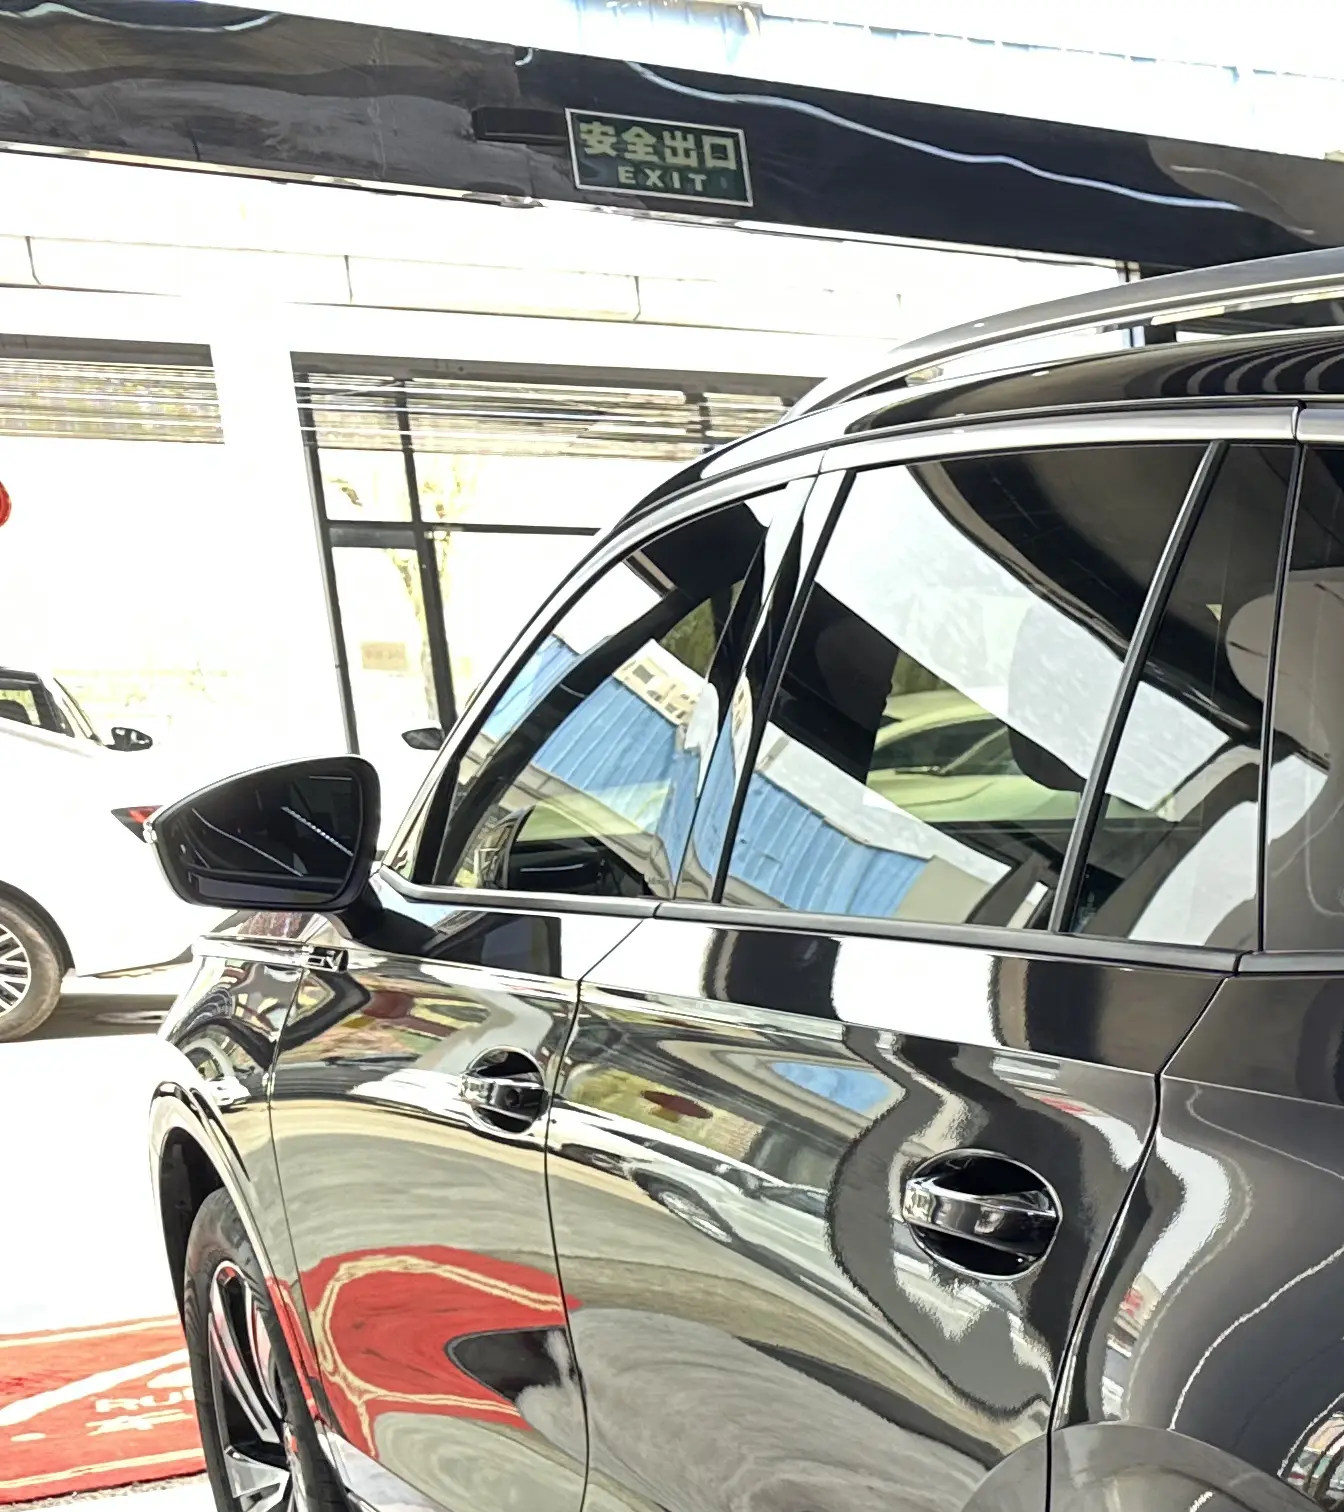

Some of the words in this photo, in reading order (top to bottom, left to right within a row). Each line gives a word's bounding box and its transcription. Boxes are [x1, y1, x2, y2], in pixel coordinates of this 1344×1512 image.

[578, 121, 738, 170] 安全出口
[617, 165, 708, 191] EXIT
